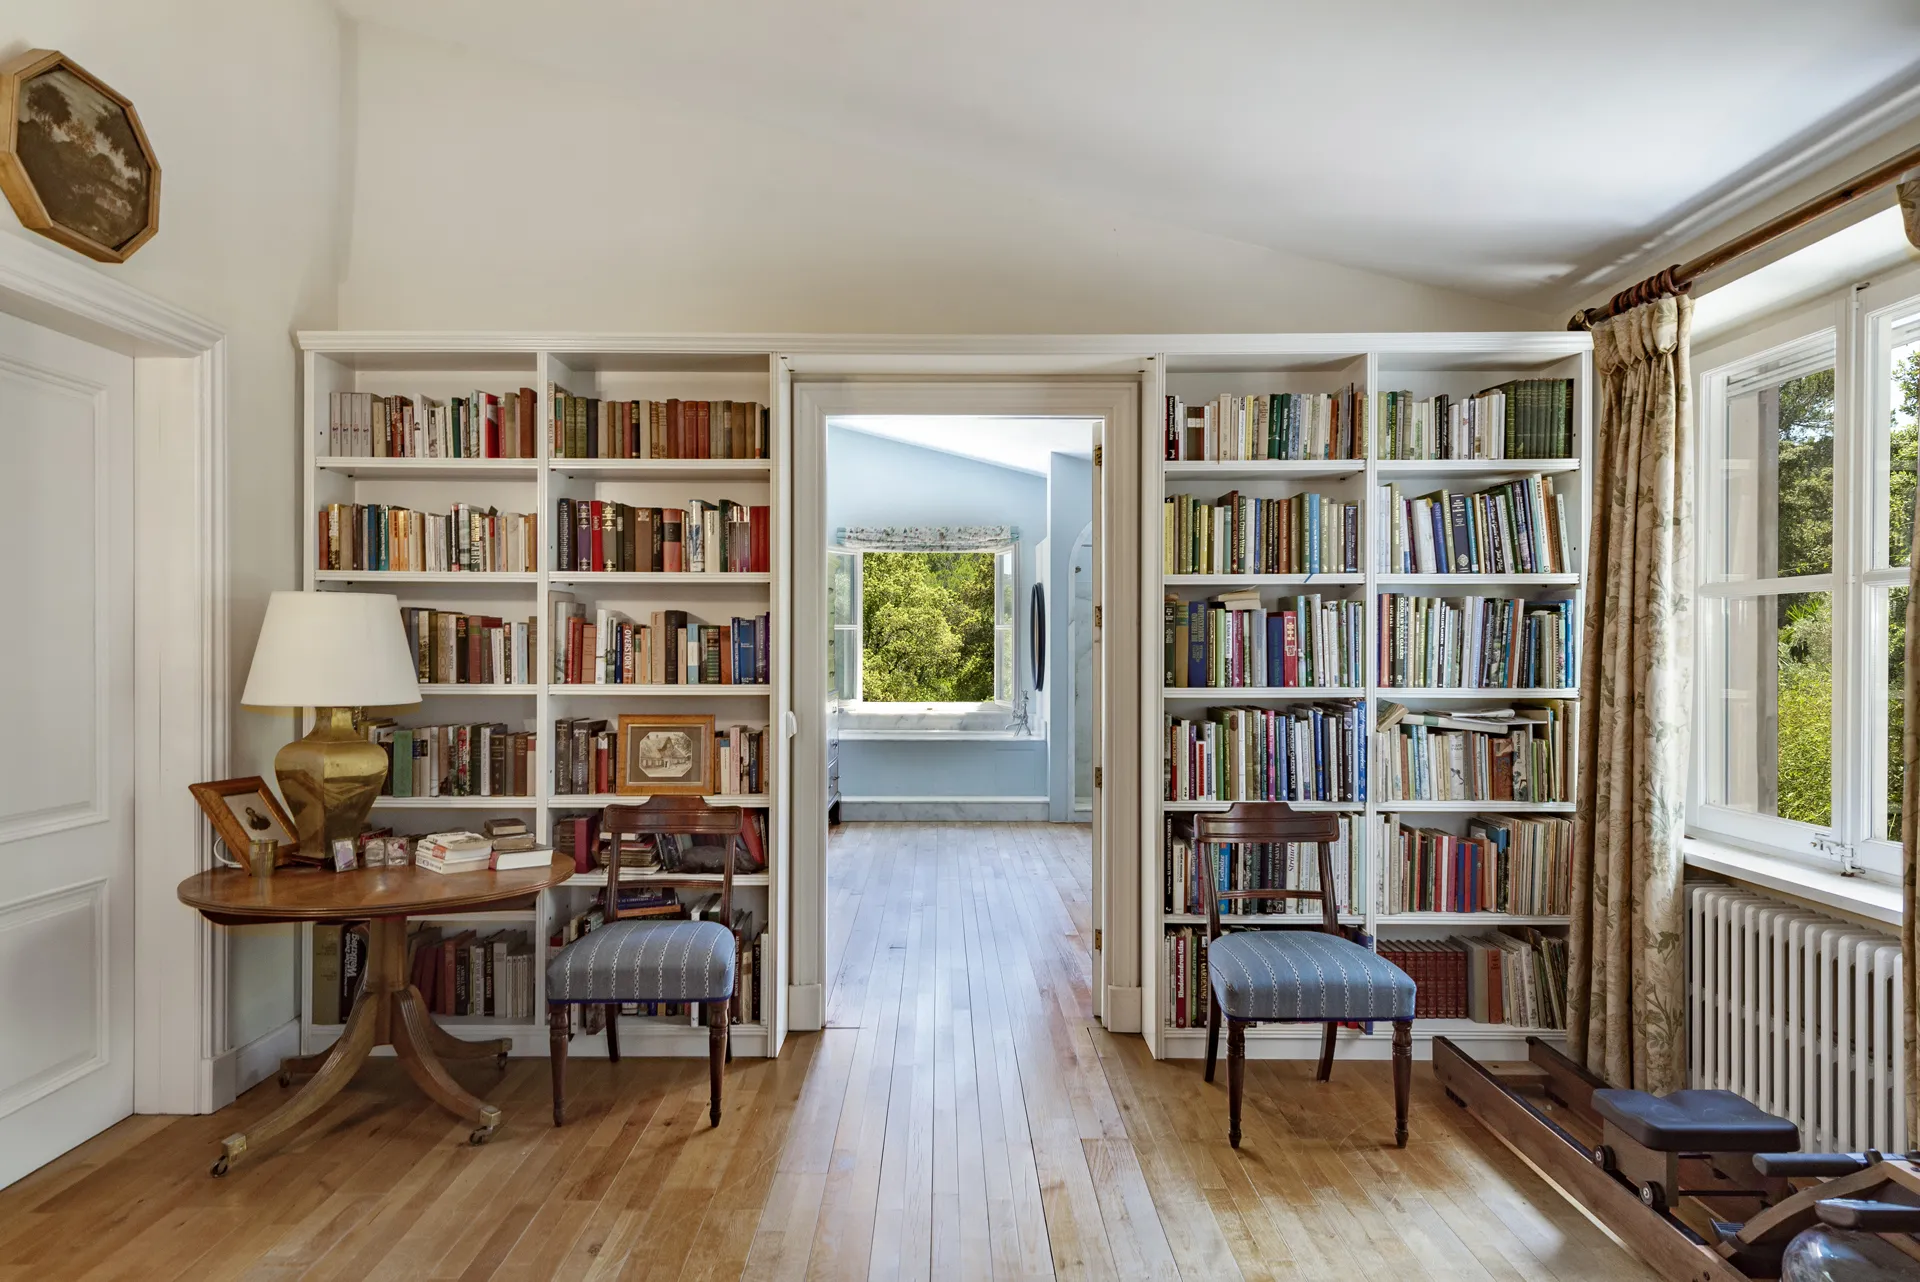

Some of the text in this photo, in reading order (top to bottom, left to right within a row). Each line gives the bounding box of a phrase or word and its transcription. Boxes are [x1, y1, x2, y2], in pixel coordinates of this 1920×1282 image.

[471, 542, 480, 564] PARIS
[624, 629, 632, 670] OVERSTORY
[347, 933, 359, 977] Weltkrieg
